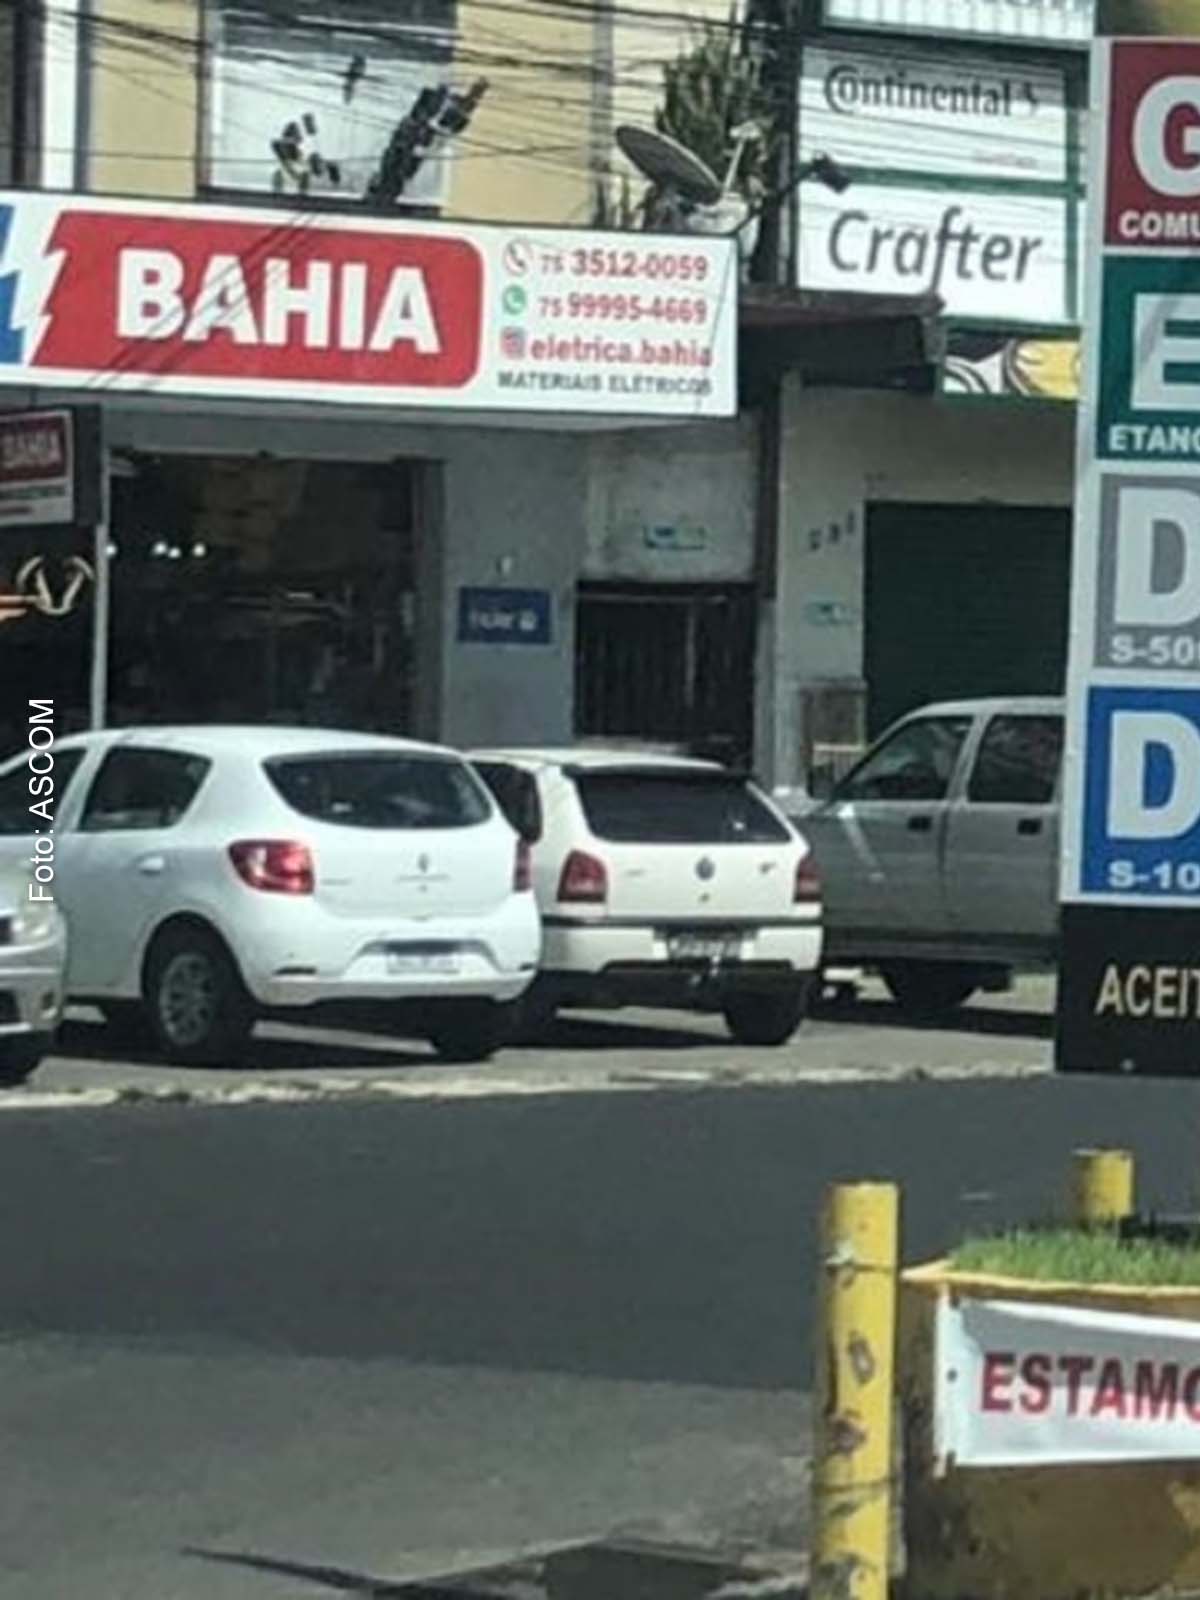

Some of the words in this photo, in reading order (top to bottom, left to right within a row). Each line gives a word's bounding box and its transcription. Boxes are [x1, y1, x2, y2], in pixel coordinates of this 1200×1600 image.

[823, 65, 1012, 117] Continental
[570, 248, 709, 281] 3512-0059
[828, 205, 1042, 293] Crafter
[116, 248, 442, 354] BAHIA
[531, 334, 712, 367] eletrica.bahia
[498, 371, 601, 392] MATERIAIS
